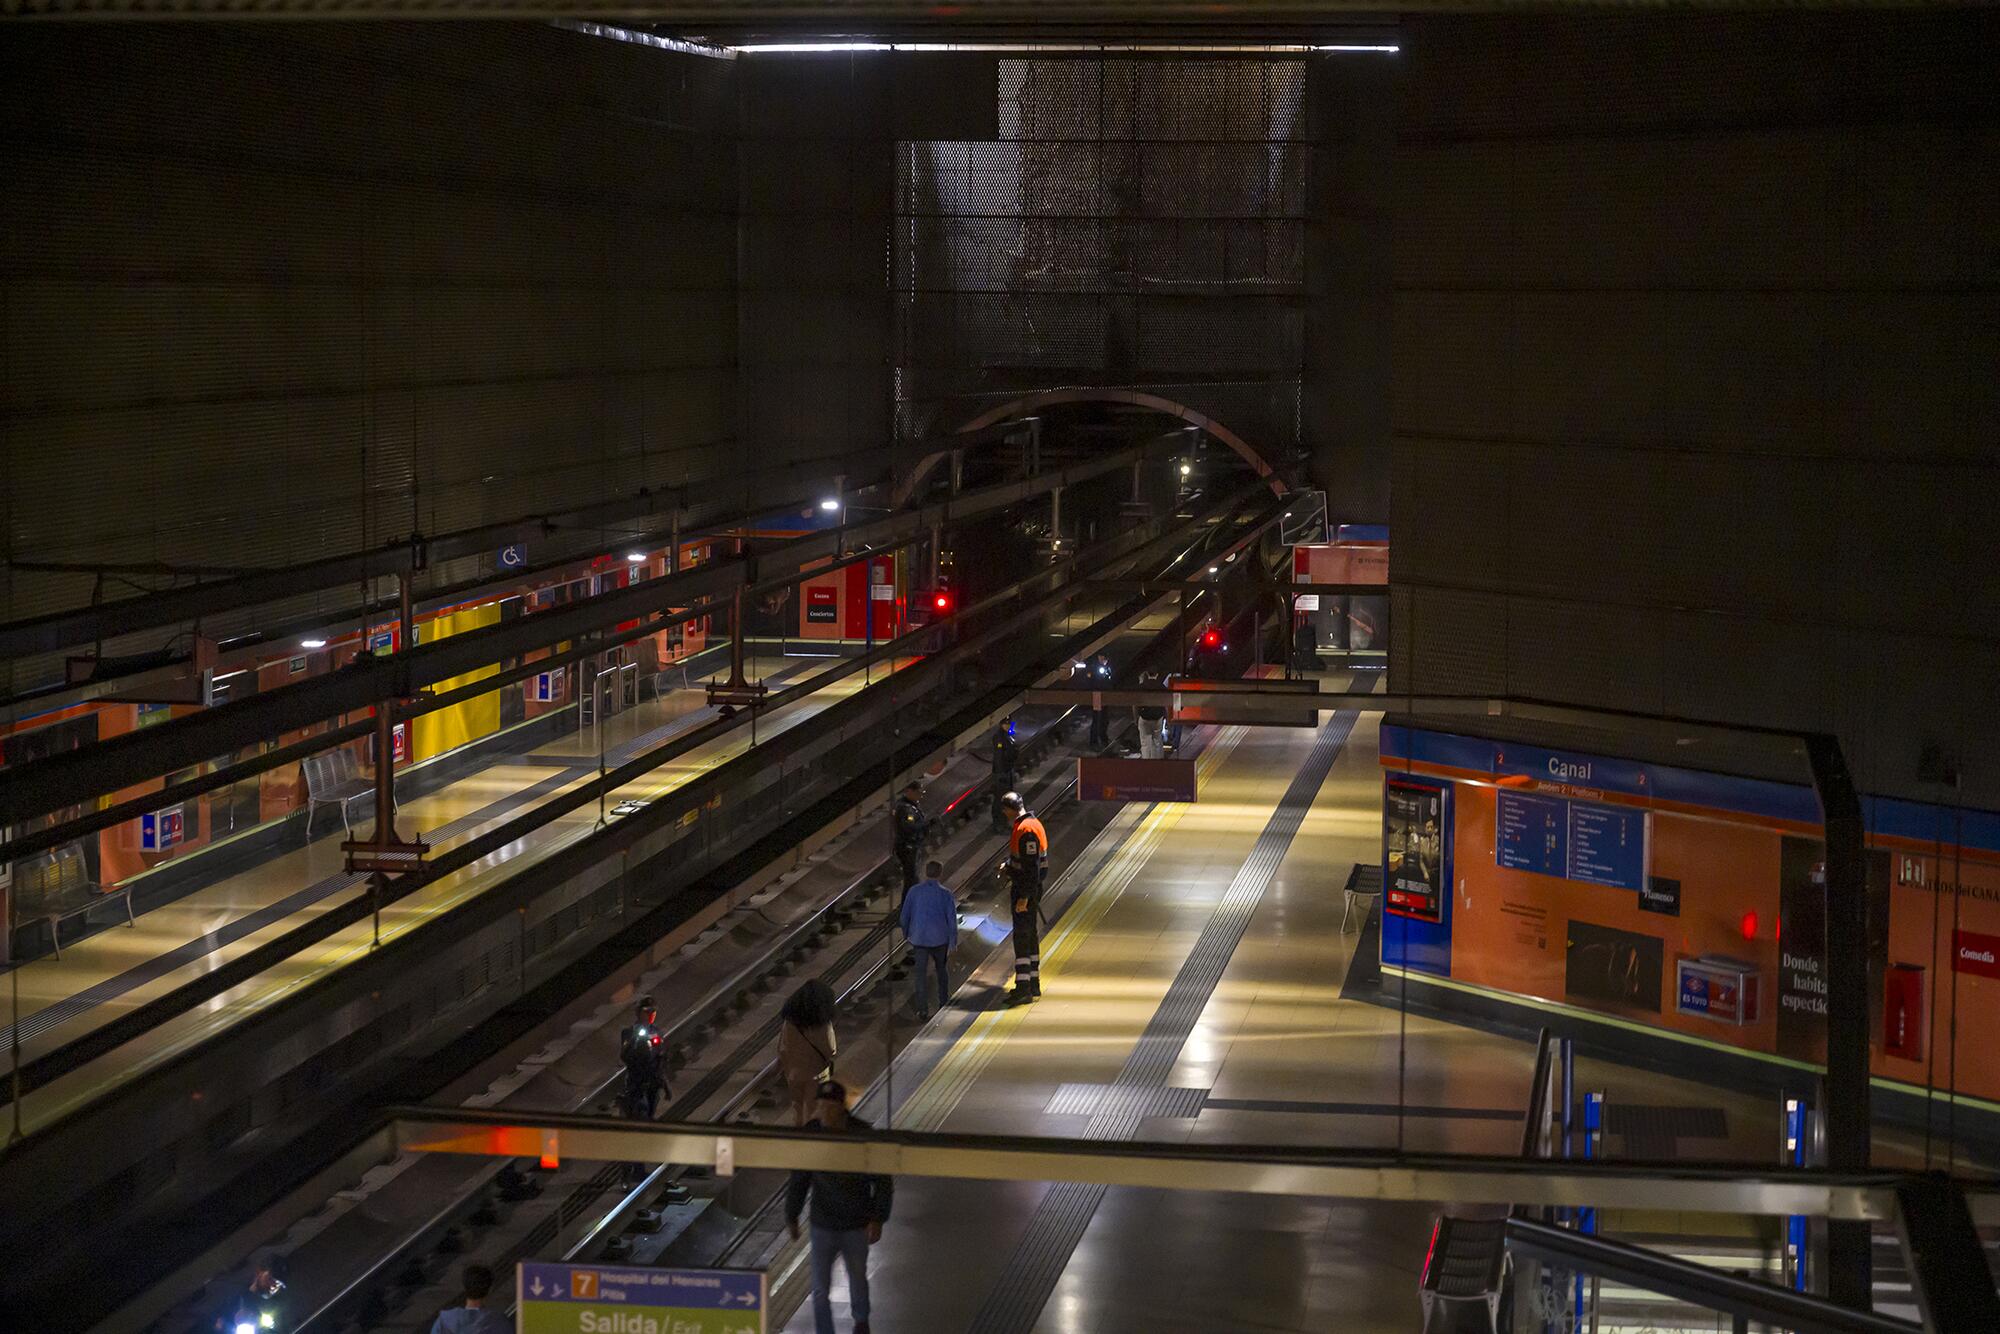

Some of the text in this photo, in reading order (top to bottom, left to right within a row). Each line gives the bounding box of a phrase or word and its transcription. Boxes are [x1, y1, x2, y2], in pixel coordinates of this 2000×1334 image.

[1548, 756, 1592, 780] Canal
[1783, 952, 1818, 972] Donde
[1960, 946, 1994, 964] Comedia
[1793, 973, 1827, 995] habita
[576, 1274, 593, 1295] 7
[601, 1272, 649, 1286] Hospital
[650, 1275, 670, 1286] del
[579, 1310, 658, 1334] Salida
